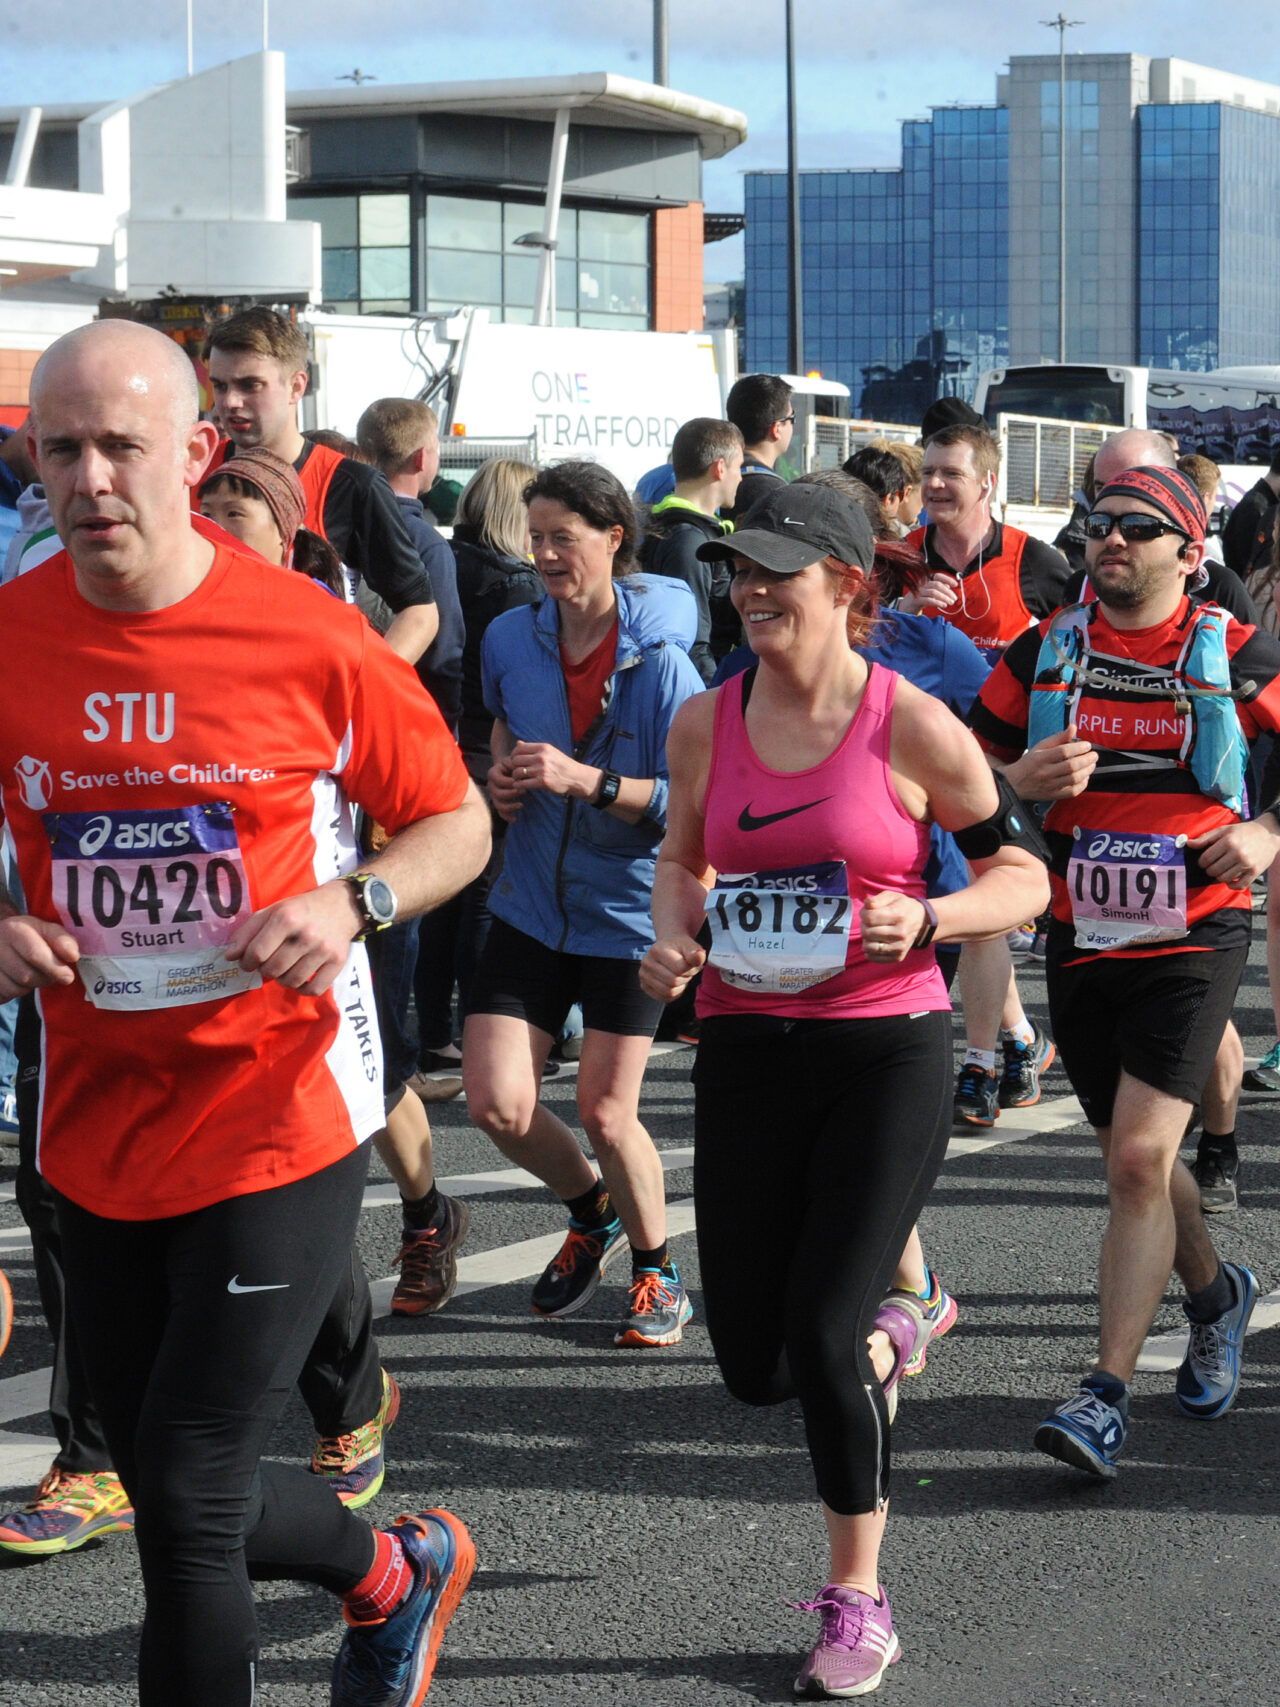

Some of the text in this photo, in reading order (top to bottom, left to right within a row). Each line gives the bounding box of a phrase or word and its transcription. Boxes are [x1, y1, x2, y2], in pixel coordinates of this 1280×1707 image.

[532, 371, 590, 403] ONE
[536, 414, 680, 447] TRAFFORD
[82, 692, 175, 742] STU
[60, 771, 120, 791] Save
[124, 766, 164, 786] the
[66, 857, 243, 928] 10420
[1075, 863, 1176, 909] 10191
[715, 891, 849, 935] 18182
[1101, 908, 1150, 920] SimonH
[121, 928, 185, 948] Stuart
[748, 937, 785, 950] Hazel
[167, 963, 215, 979] GREATER
[167, 967, 240, 988] MANCHESTER
[780, 967, 814, 976] GREATER
[166, 979, 227, 998] MARATHON
[345, 997, 378, 1083] TAKES
